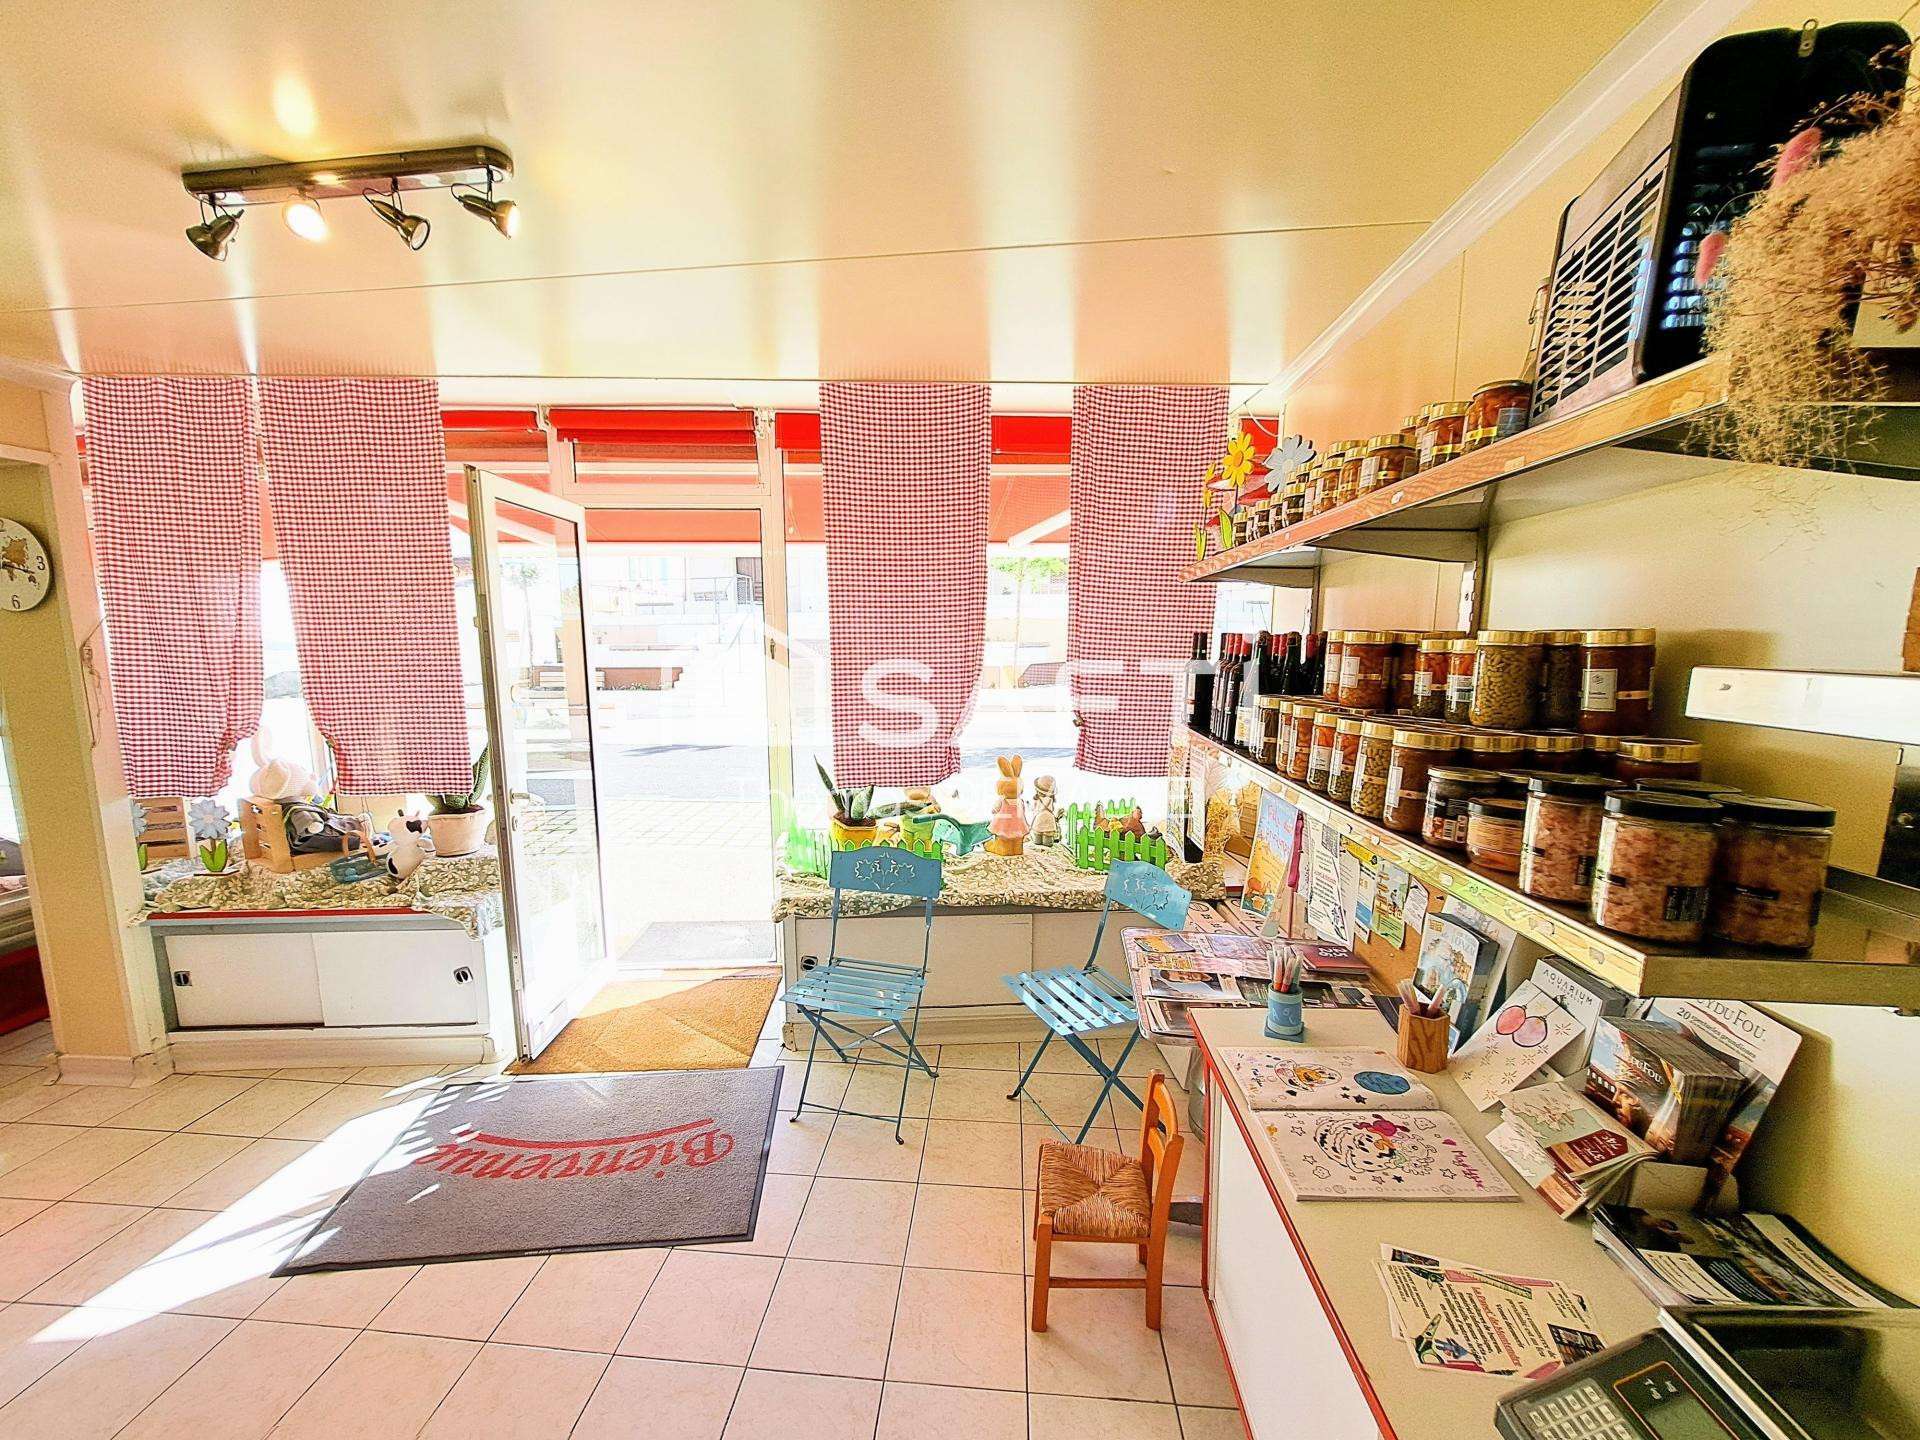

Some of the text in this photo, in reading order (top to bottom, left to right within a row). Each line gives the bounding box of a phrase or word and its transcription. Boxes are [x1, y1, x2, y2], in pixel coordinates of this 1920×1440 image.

[36, 555, 46, 571] 3
[11, 594, 21, 610] 6
[1542, 967, 1594, 1006] AQUARIUM
[1676, 1006, 1692, 1021] 20
[415, 1127, 737, 1182] Bienvenue
